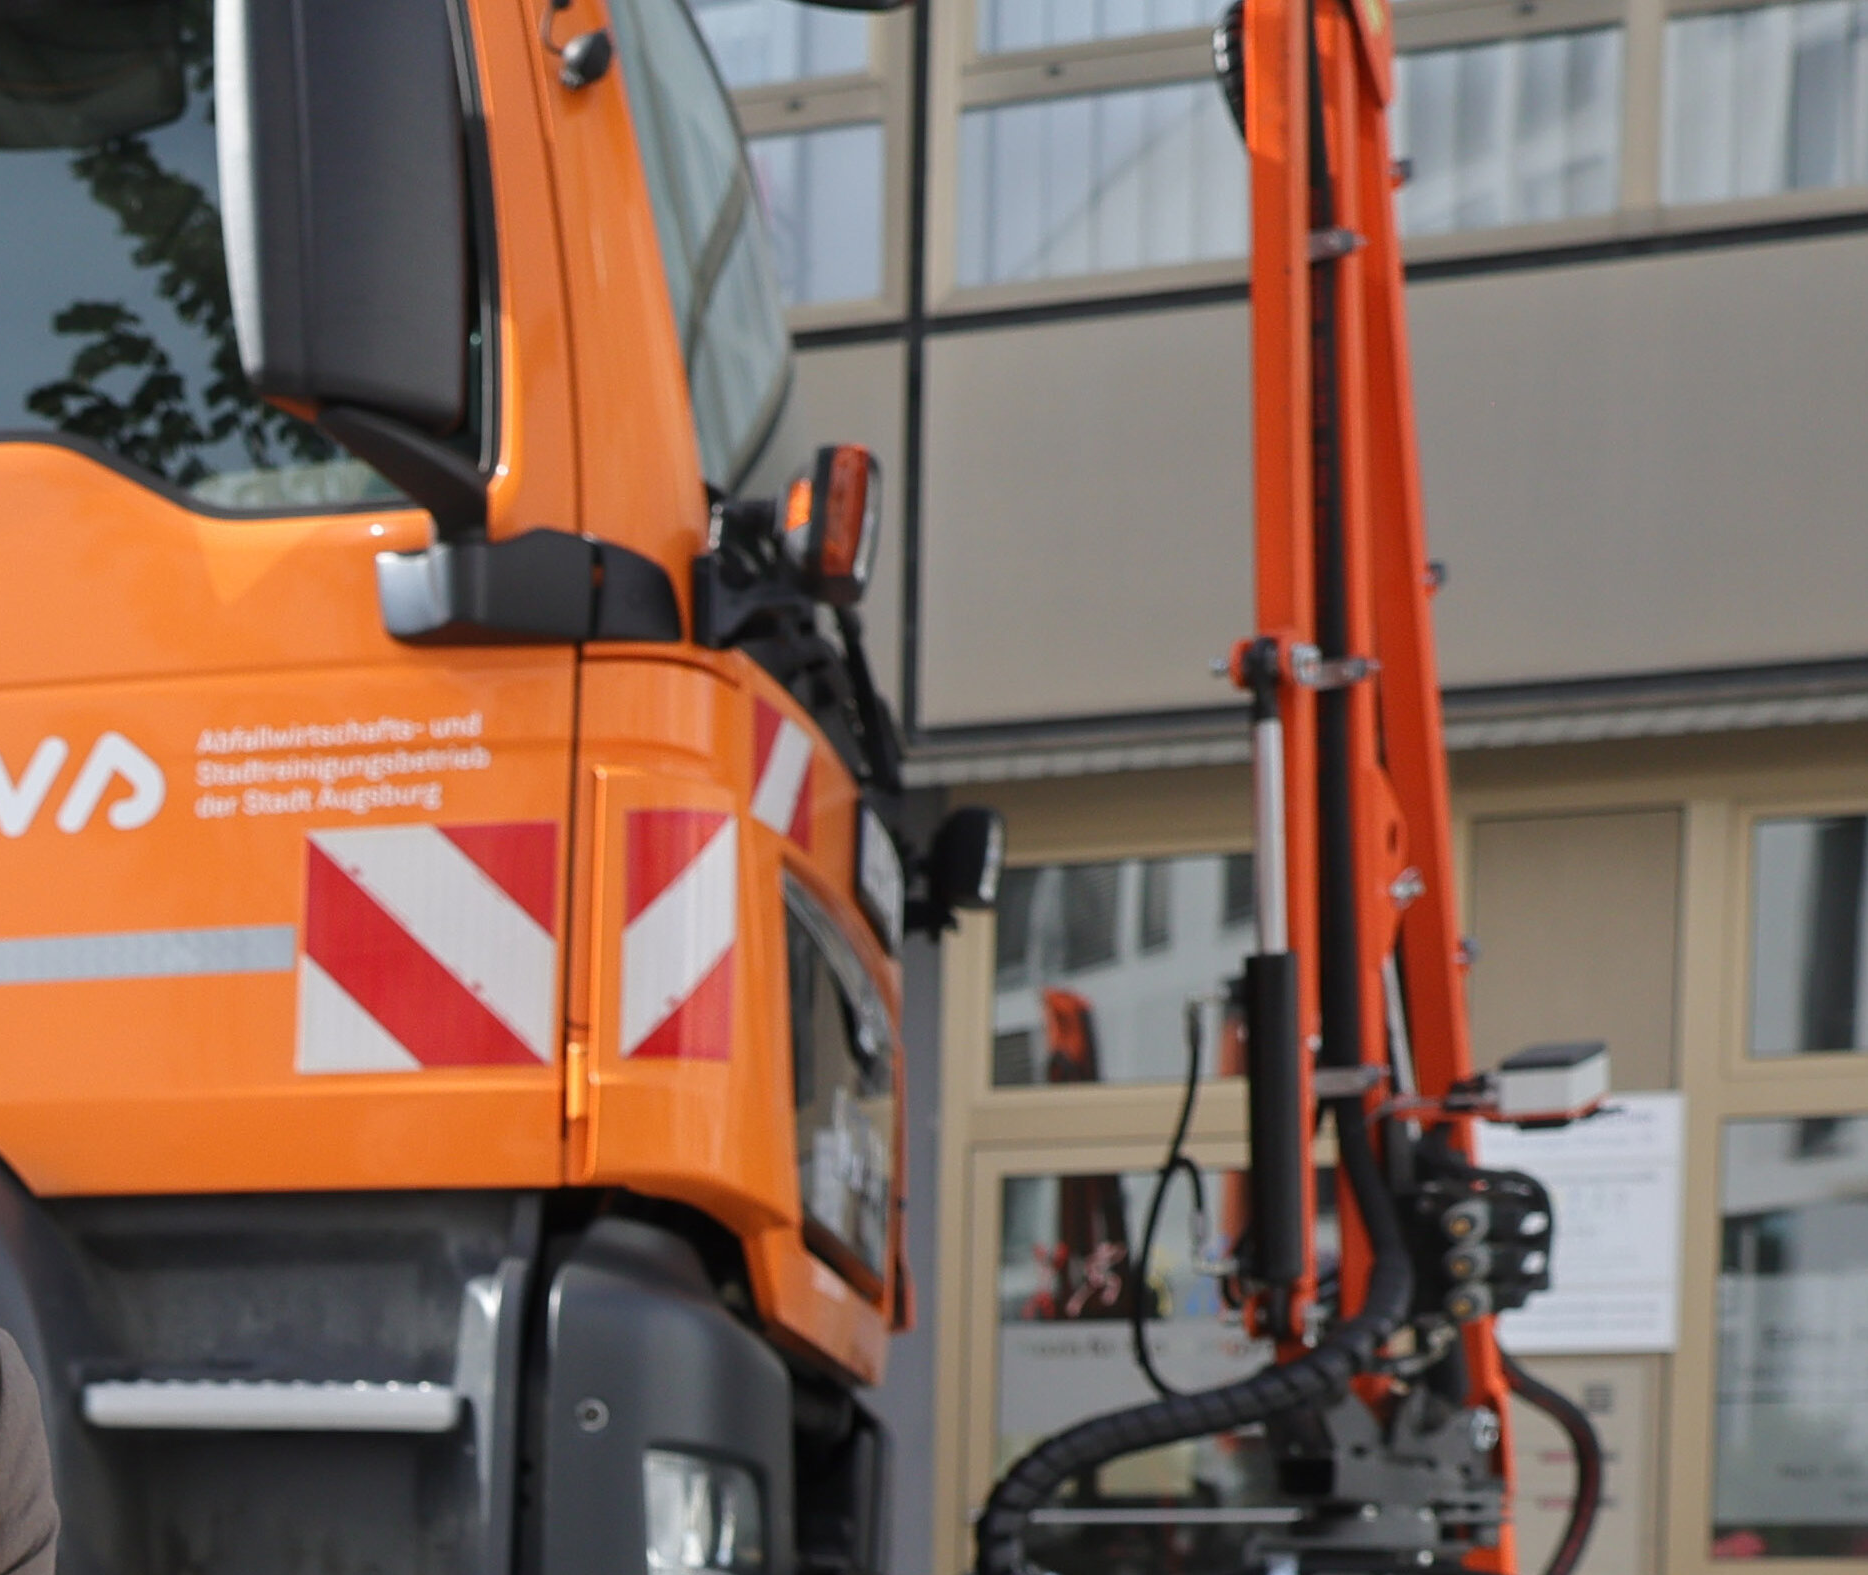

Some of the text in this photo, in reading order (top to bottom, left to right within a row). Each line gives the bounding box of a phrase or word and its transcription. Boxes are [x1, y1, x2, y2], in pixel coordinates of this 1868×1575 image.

[196, 711, 483, 754] Abfallwirtschafts- und
[196, 744, 492, 787] Stadtreinigungsbetrieb
[194, 782, 443, 819] der Stadt Augsburg
